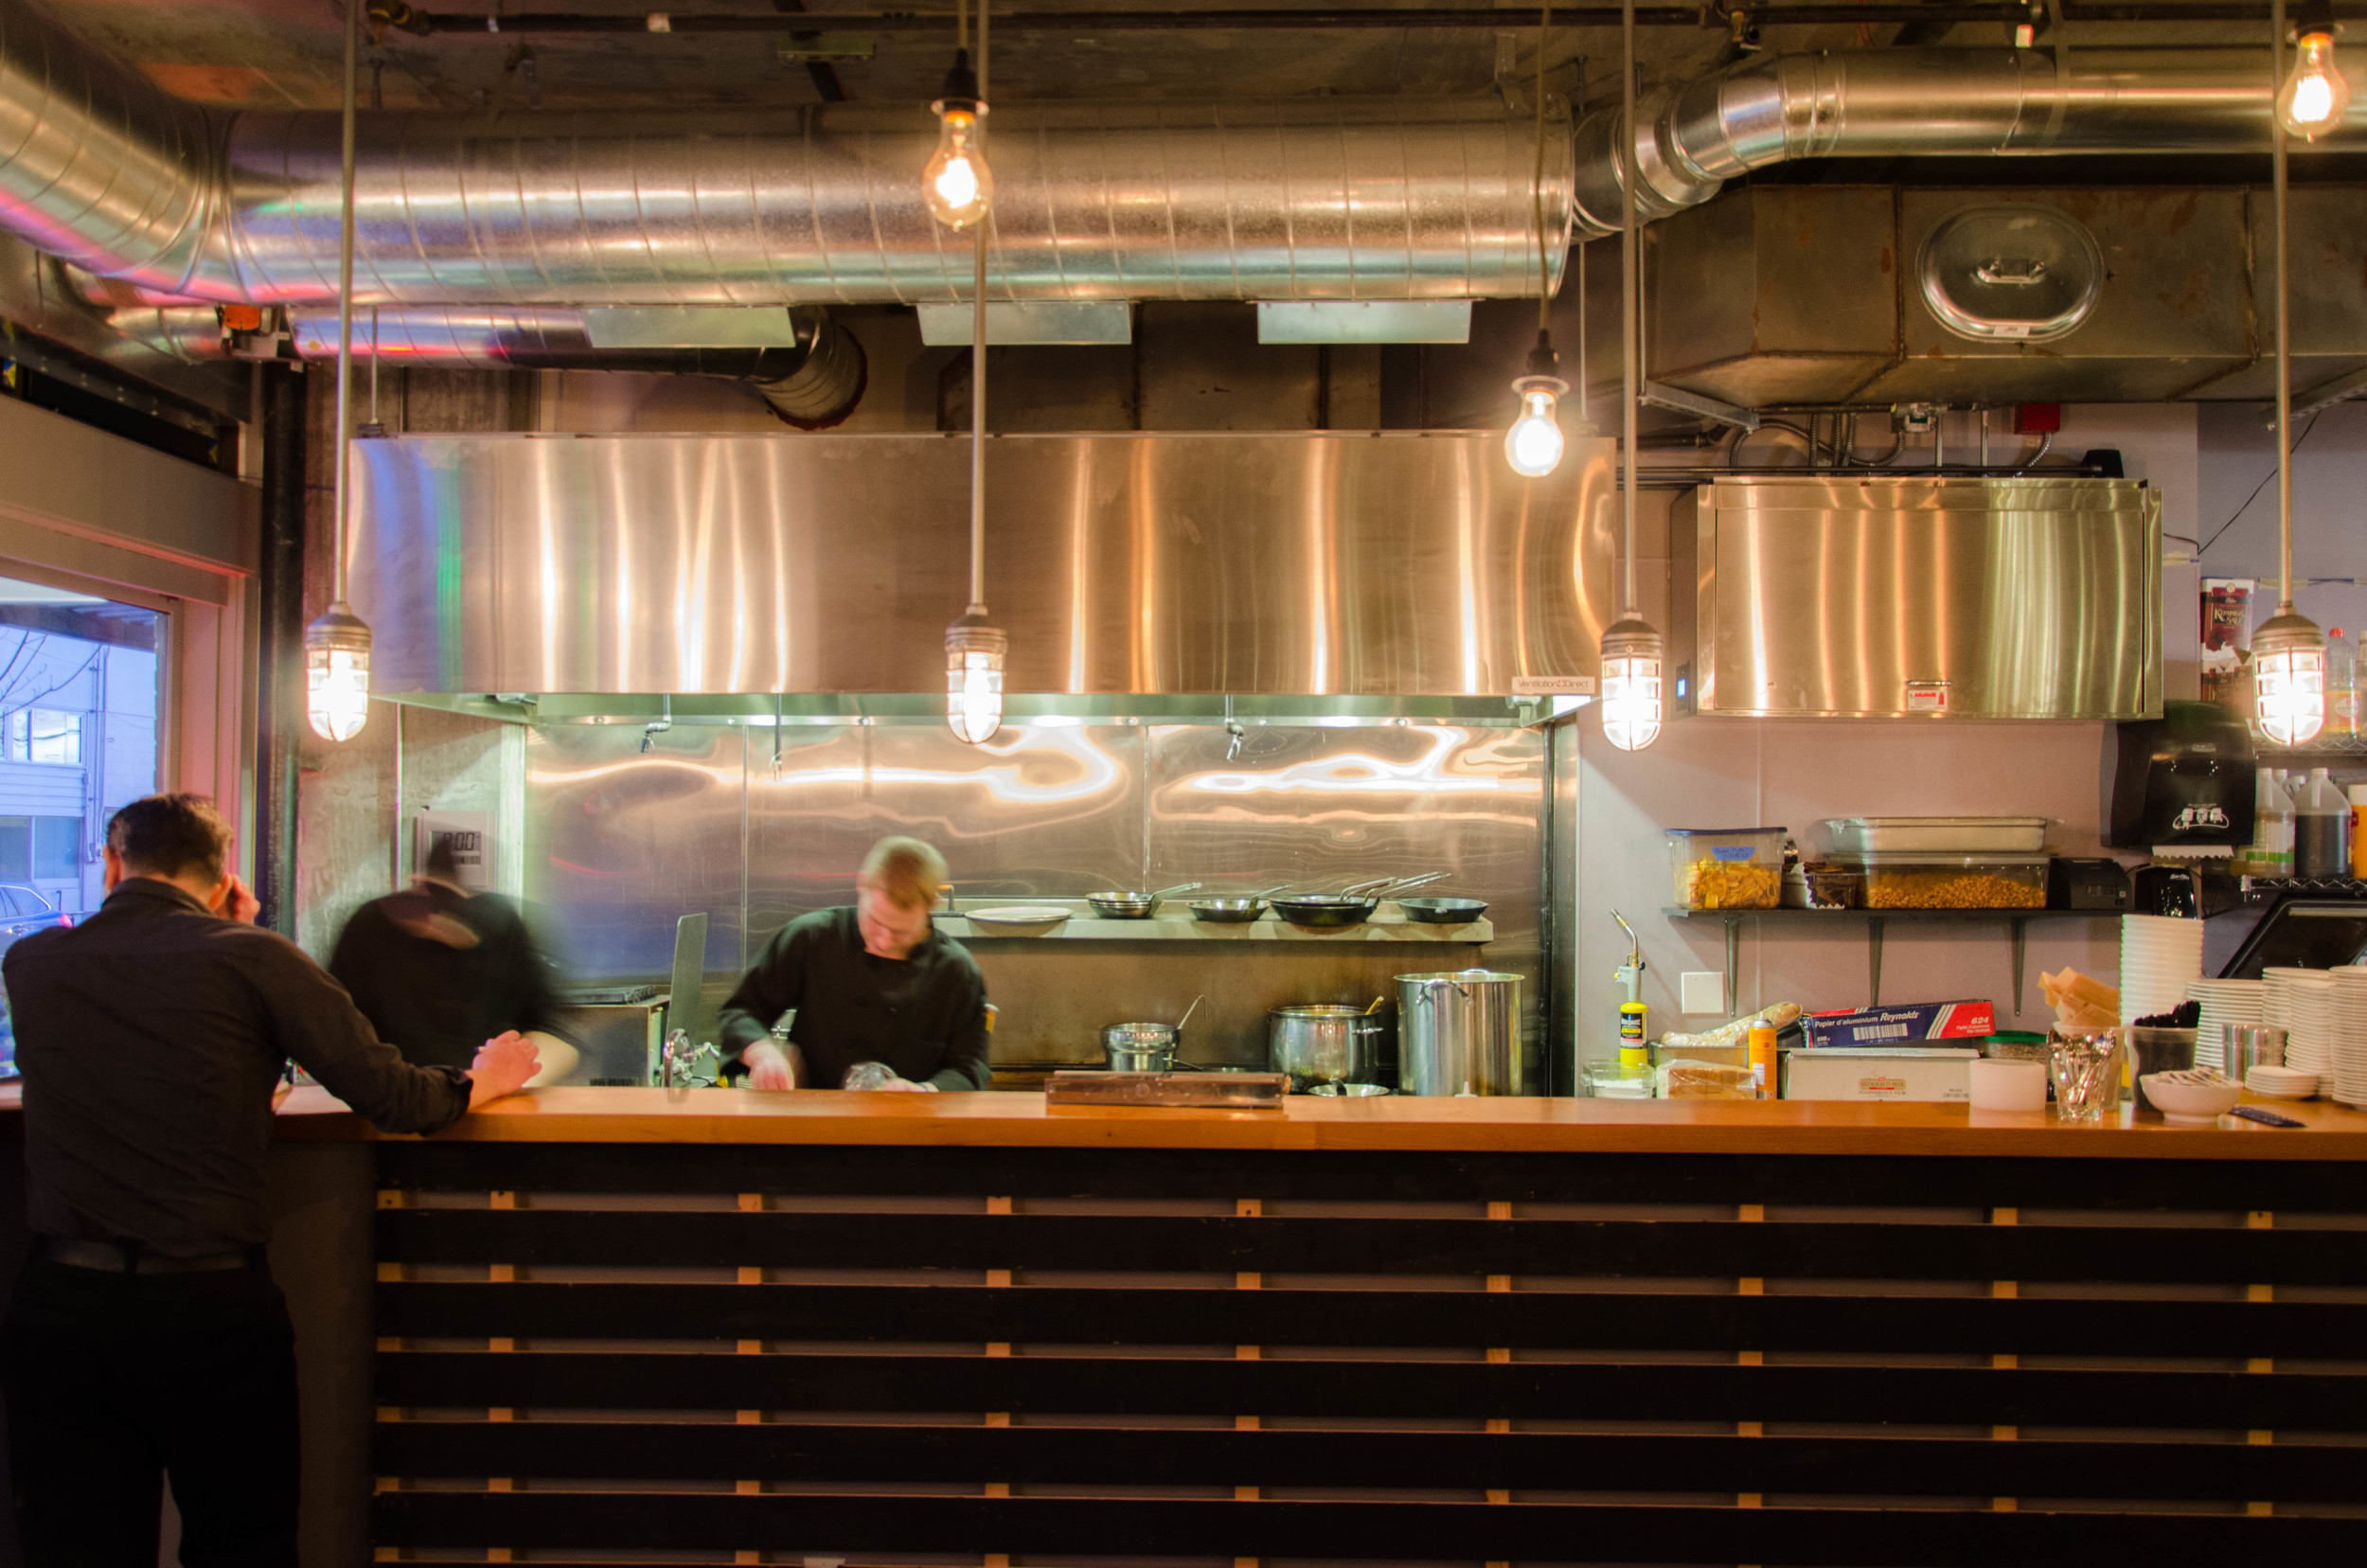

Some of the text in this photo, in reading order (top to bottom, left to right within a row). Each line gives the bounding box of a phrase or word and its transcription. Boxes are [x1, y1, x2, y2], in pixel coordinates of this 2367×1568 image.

[1518, 679, 1589, 688] Ventilation Direct
[1836, 1017, 1878, 1025] d'aluminium
[1879, 1011, 1919, 1024] Reynolds
[1971, 1016, 1989, 1025] 624
